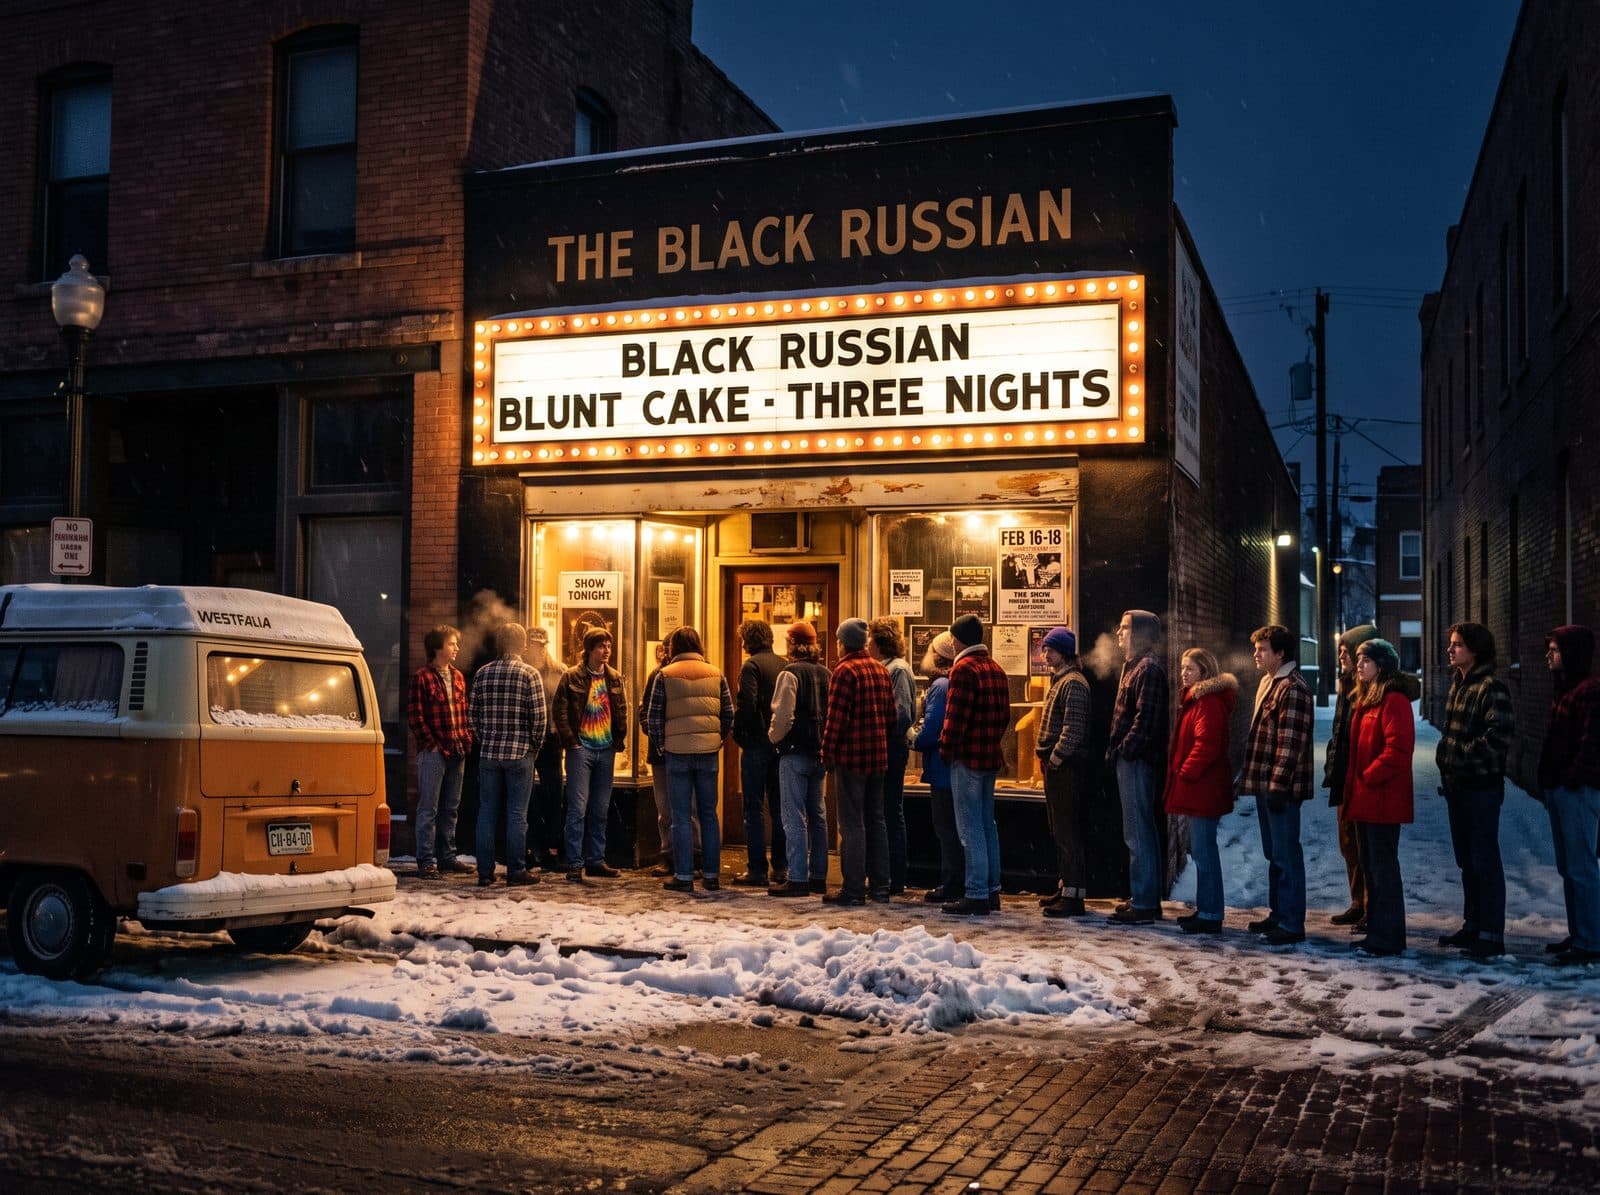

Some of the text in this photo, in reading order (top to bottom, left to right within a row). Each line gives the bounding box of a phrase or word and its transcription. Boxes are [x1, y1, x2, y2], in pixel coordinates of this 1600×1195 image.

[548, 188, 1073, 283] THE BLACK RUSSIAN
[622, 323, 970, 378] BLACK RUSSIAN
[499, 392, 622, 432] BLUNT
[643, 386, 750, 425] CAKE
[788, 378, 924, 419] THREE
[945, 368, 1111, 414] NIGHTS
[66, 523, 78, 531] NO
[1001, 529, 1061, 546] FEB 16-18
[575, 579, 605, 588] SHOW
[568, 590, 611, 600] TONIGHT
[197, 610, 272, 629] WESTFALIA
